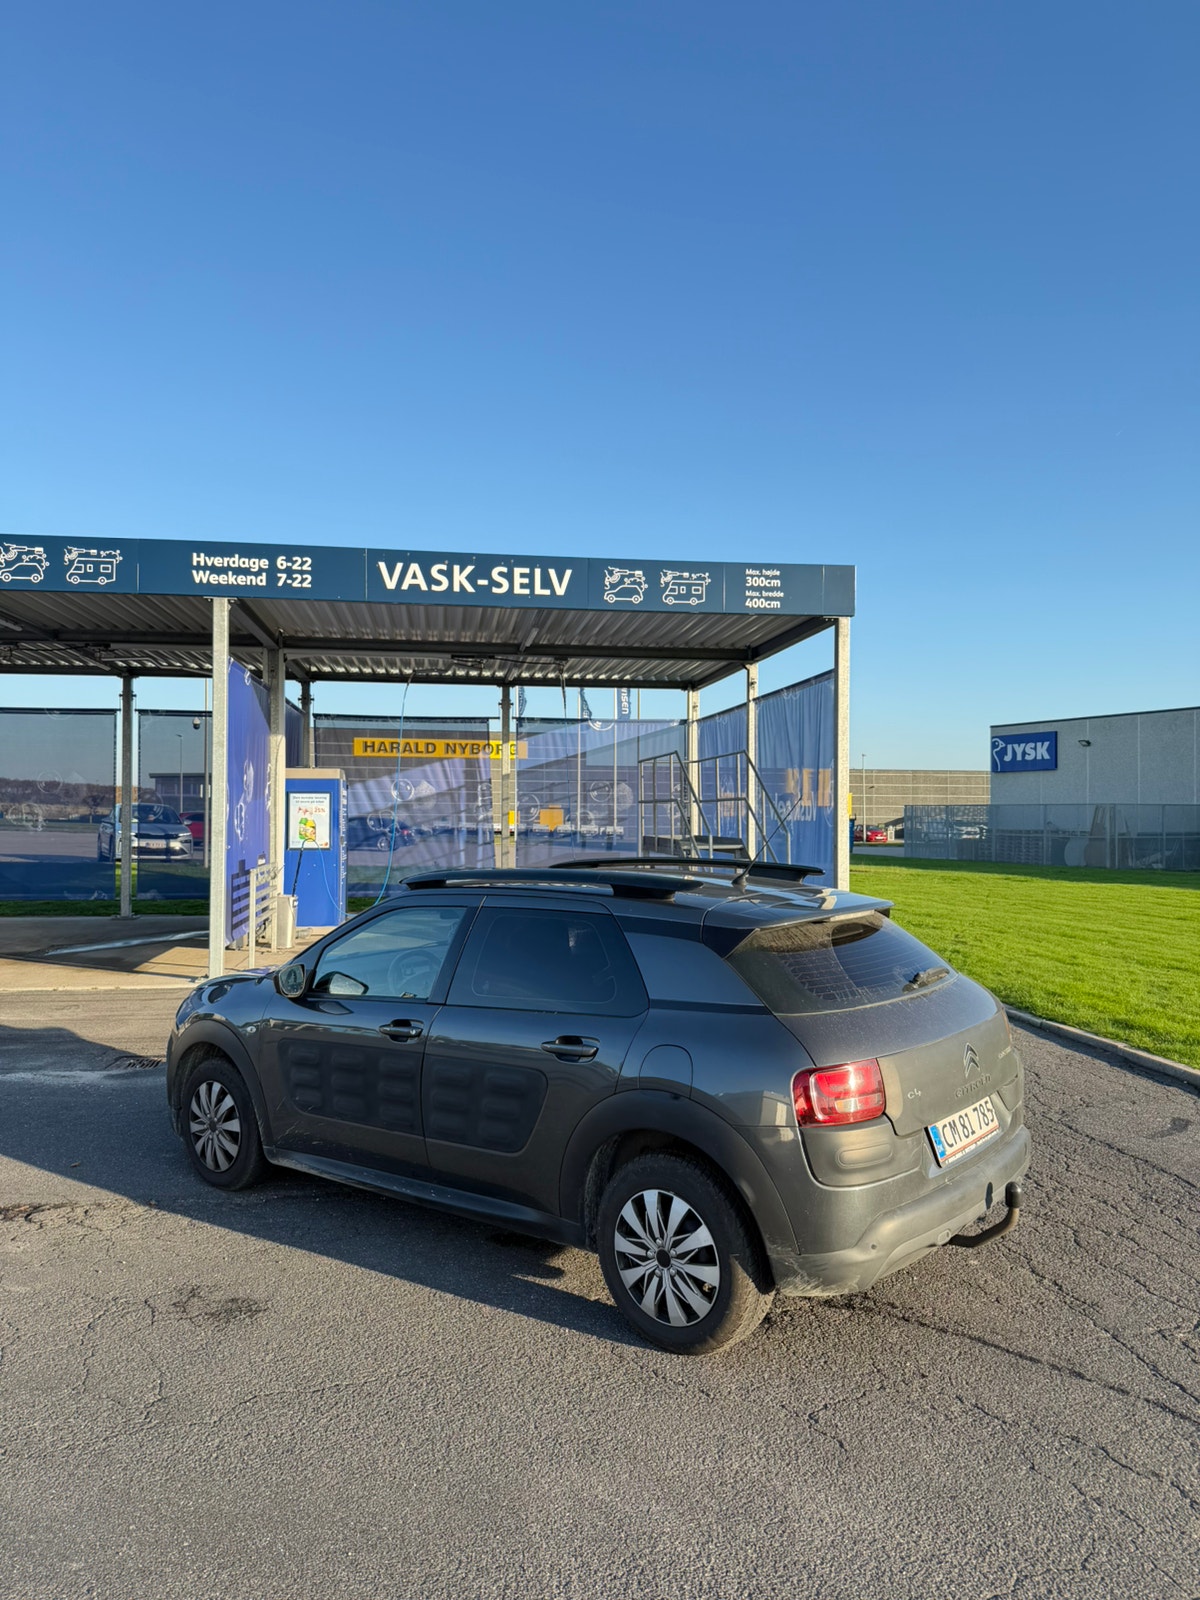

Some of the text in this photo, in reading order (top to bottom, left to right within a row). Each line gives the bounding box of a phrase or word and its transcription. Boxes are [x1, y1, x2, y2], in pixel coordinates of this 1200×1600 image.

[192, 552, 312, 572] Hverdage 6-22
[192, 570, 312, 588] Weekend 7-22
[377, 561, 573, 596] VASK-SELV
[745, 576, 781, 587] 300cm
[762, 590, 784, 598] bredde
[745, 598, 781, 609] 400cm
[362, 740, 437, 755] HARALD
[1003, 741, 1051, 762] JYSK
[941, 1119, 962, 1149] CM
[958, 1112, 976, 1139] 81
[972, 1100, 995, 1131] 785
